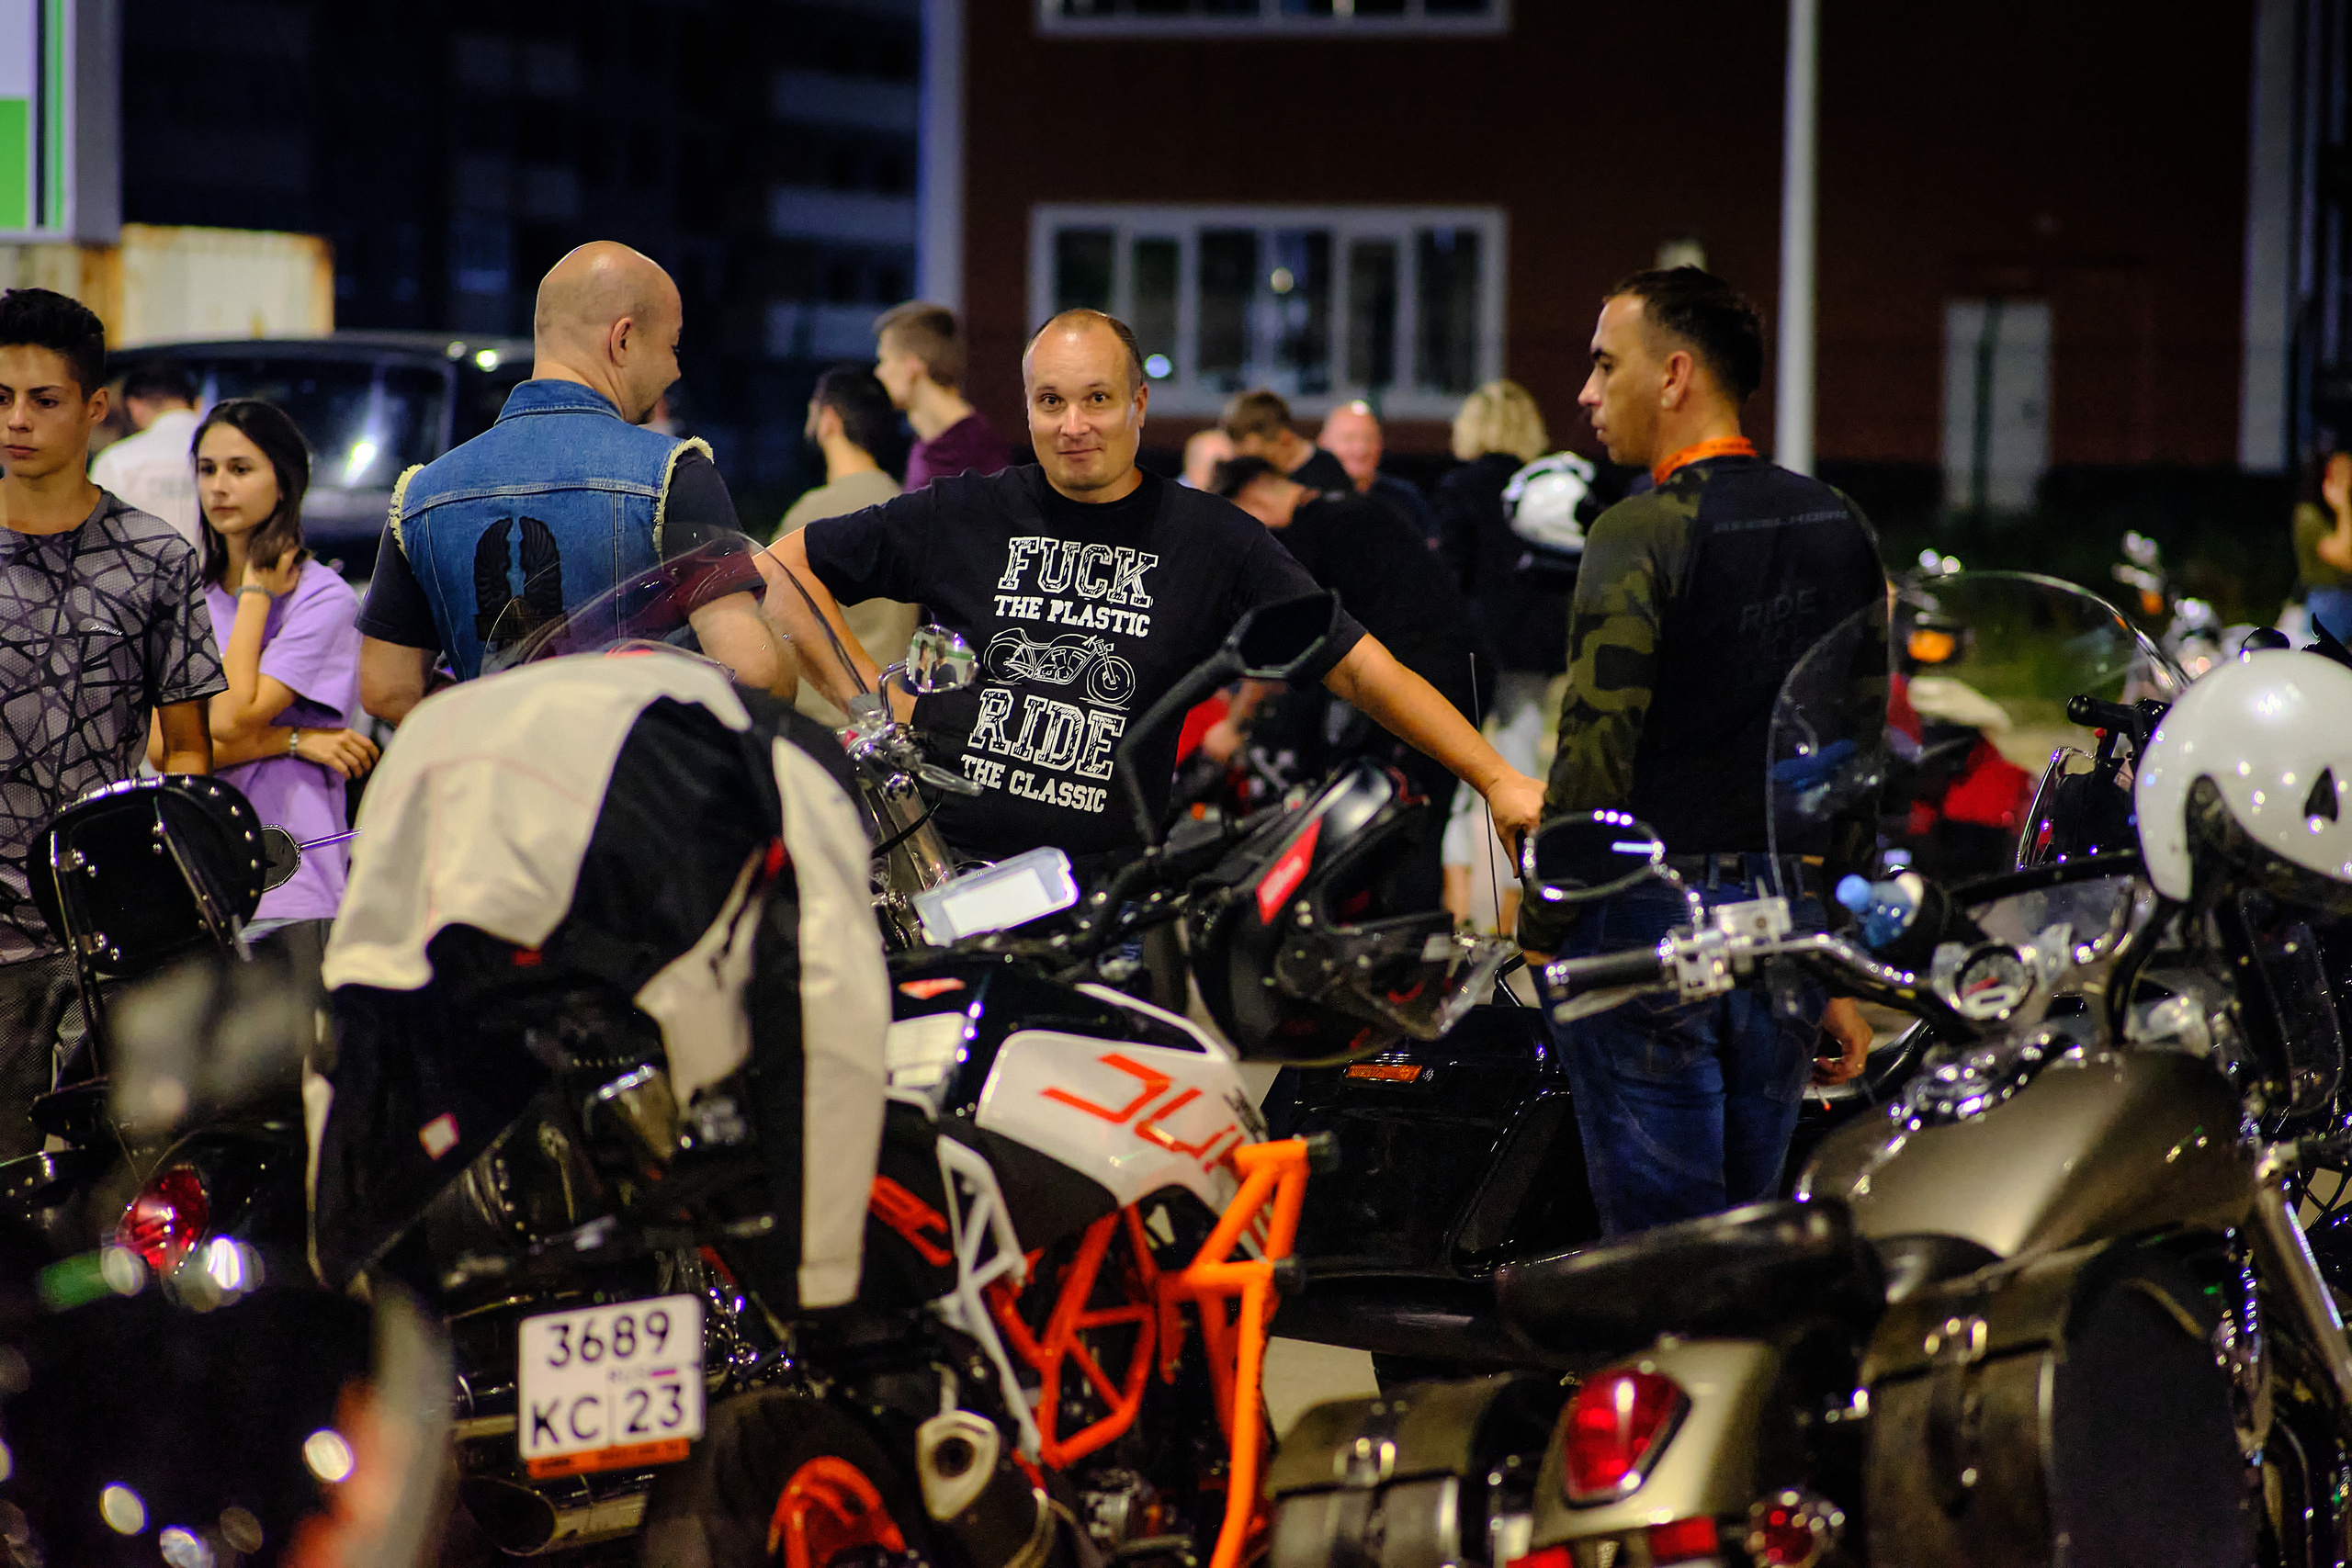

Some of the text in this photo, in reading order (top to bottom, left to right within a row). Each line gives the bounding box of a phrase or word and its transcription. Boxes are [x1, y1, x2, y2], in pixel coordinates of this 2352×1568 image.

[998, 536, 1159, 608] FUCK
[993, 595, 1150, 637] THE PLASTIC
[967, 688, 1126, 780] RIDE
[961, 754, 1107, 813] THE CLASSIC
[548, 1311, 669, 1367] 3689
[625, 1384, 683, 1434] 23
